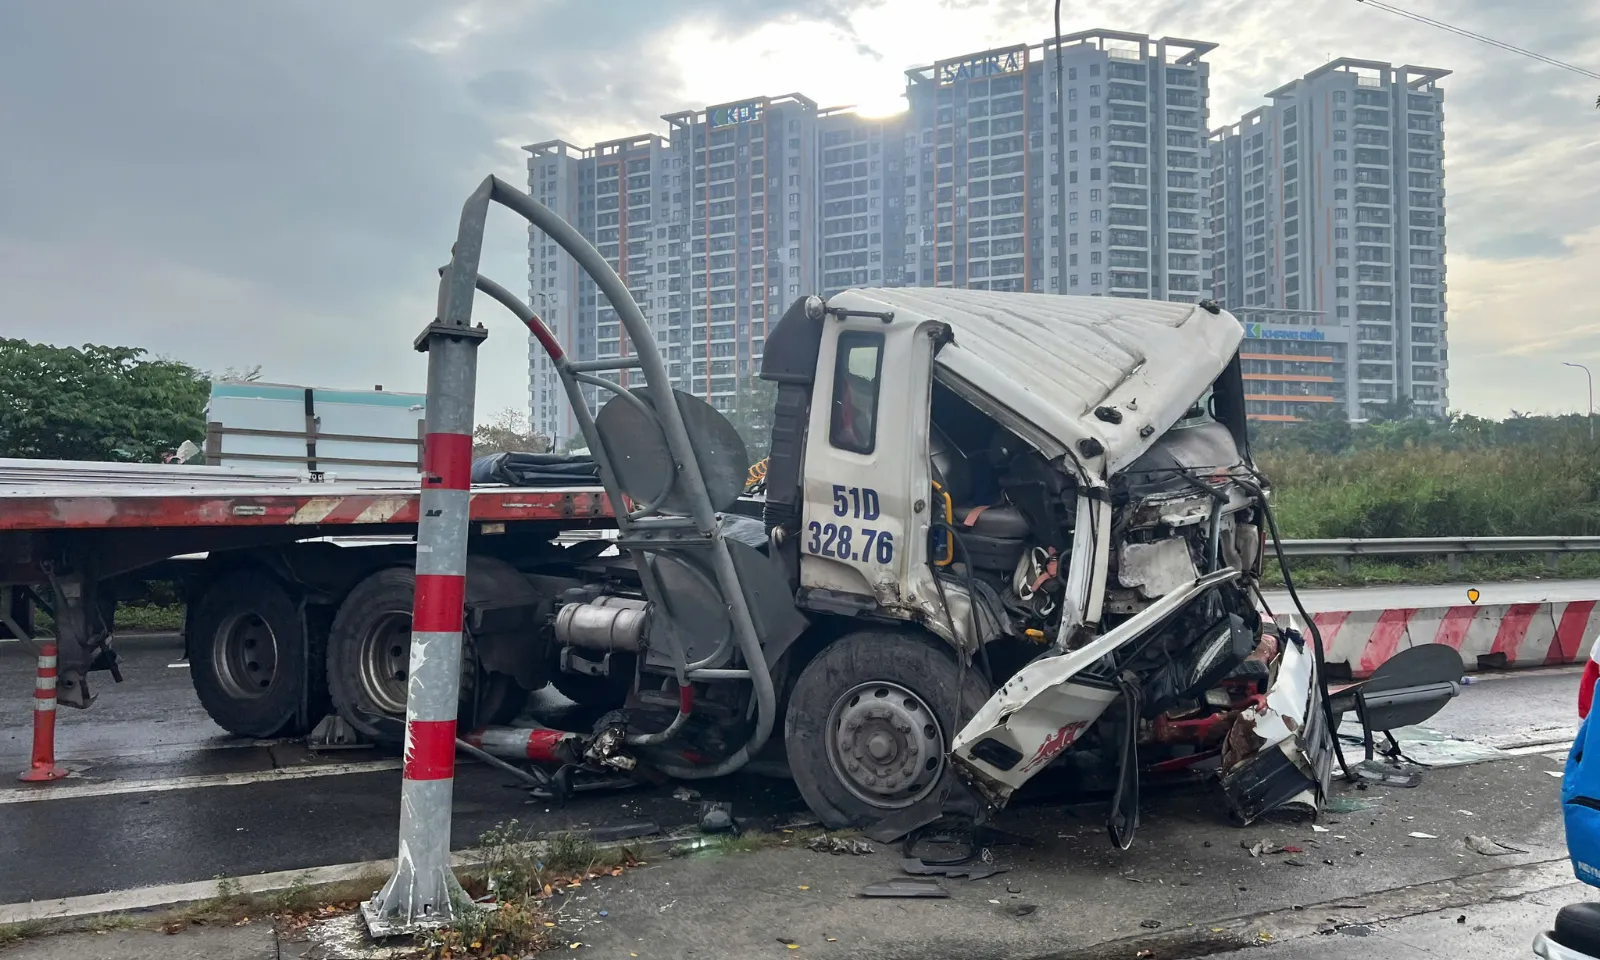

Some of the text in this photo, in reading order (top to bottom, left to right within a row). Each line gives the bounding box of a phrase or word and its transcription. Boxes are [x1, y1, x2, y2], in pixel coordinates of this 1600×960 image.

[943, 52, 1019, 82] SAFIRA
[832, 484, 880, 520] 51D
[808, 521, 894, 564] 328.76
